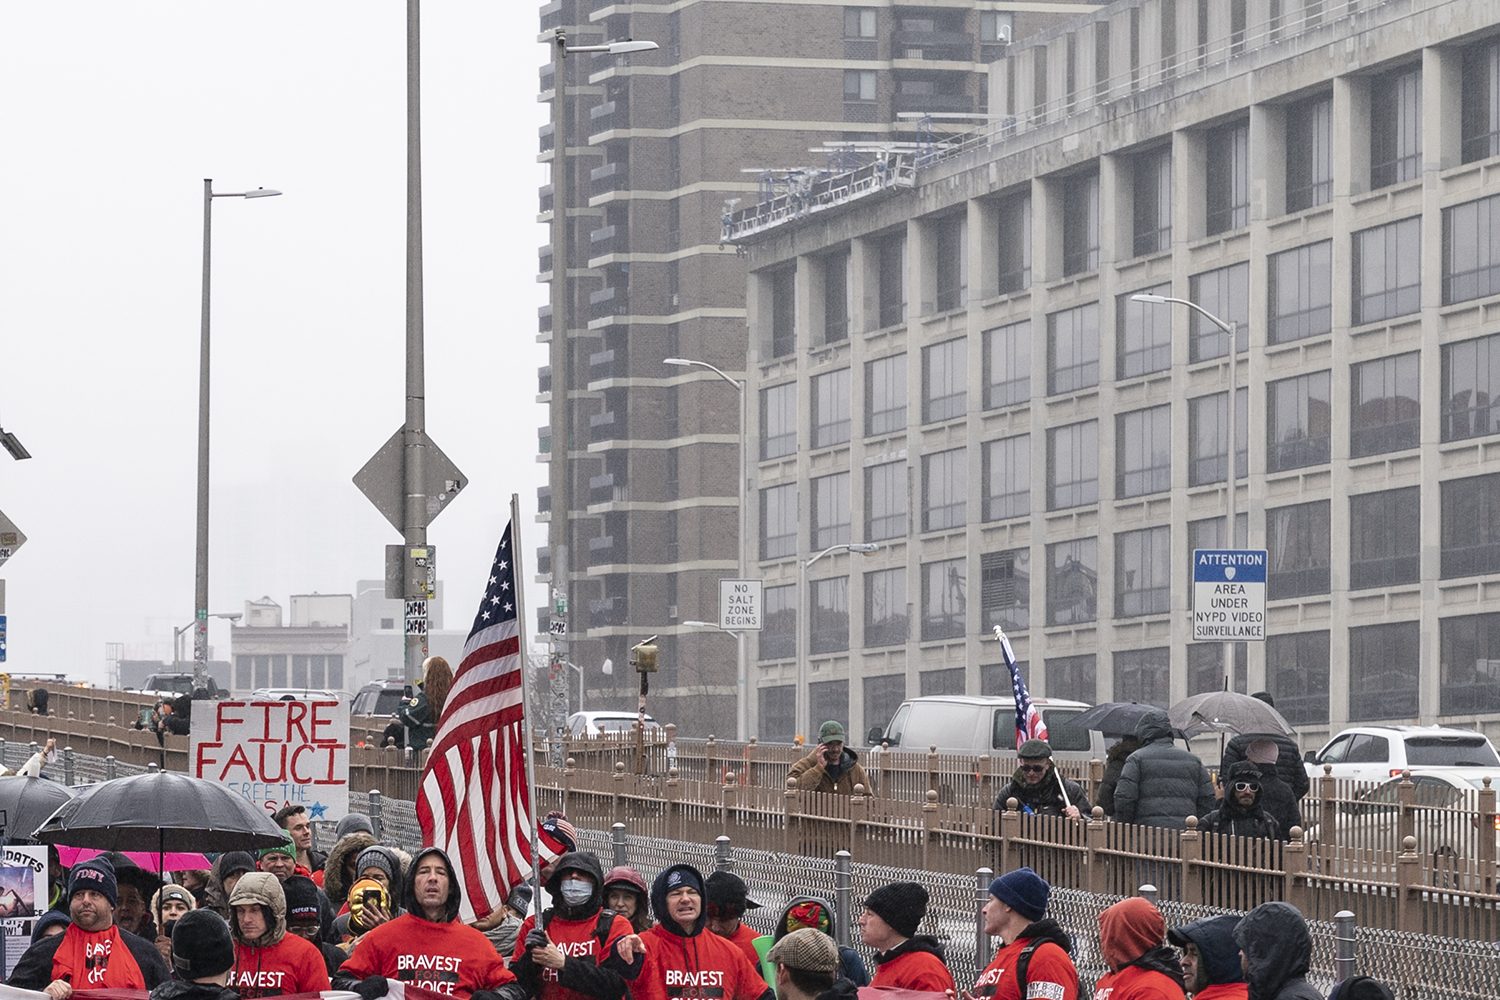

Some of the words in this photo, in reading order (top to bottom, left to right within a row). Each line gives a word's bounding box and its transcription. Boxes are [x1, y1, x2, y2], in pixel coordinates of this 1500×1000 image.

[1199, 554, 1262, 565] ATTENTION
[735, 585, 748, 593] NO
[1214, 584, 1245, 594] AREA
[728, 595, 754, 604] SALT
[1211, 598, 1248, 608] UNDER
[728, 606, 754, 614] ZONE
[725, 616, 757, 625] BEGINS
[1196, 612, 1226, 622] NYPD
[1232, 612, 1262, 622] VIDEO
[1196, 626, 1261, 636] SURVEILLANCE
[215, 701, 339, 744] FIRE
[196, 743, 346, 785] FAUCI
[280, 783, 311, 802] THE
[75, 868, 105, 882] FDNY
[556, 940, 596, 957] AVEST
[398, 954, 462, 972] BRAVEST
[415, 970, 440, 980] FOR
[665, 970, 724, 986] BRAVEST
[240, 988, 264, 998] FOR
[682, 988, 706, 997] FOR
